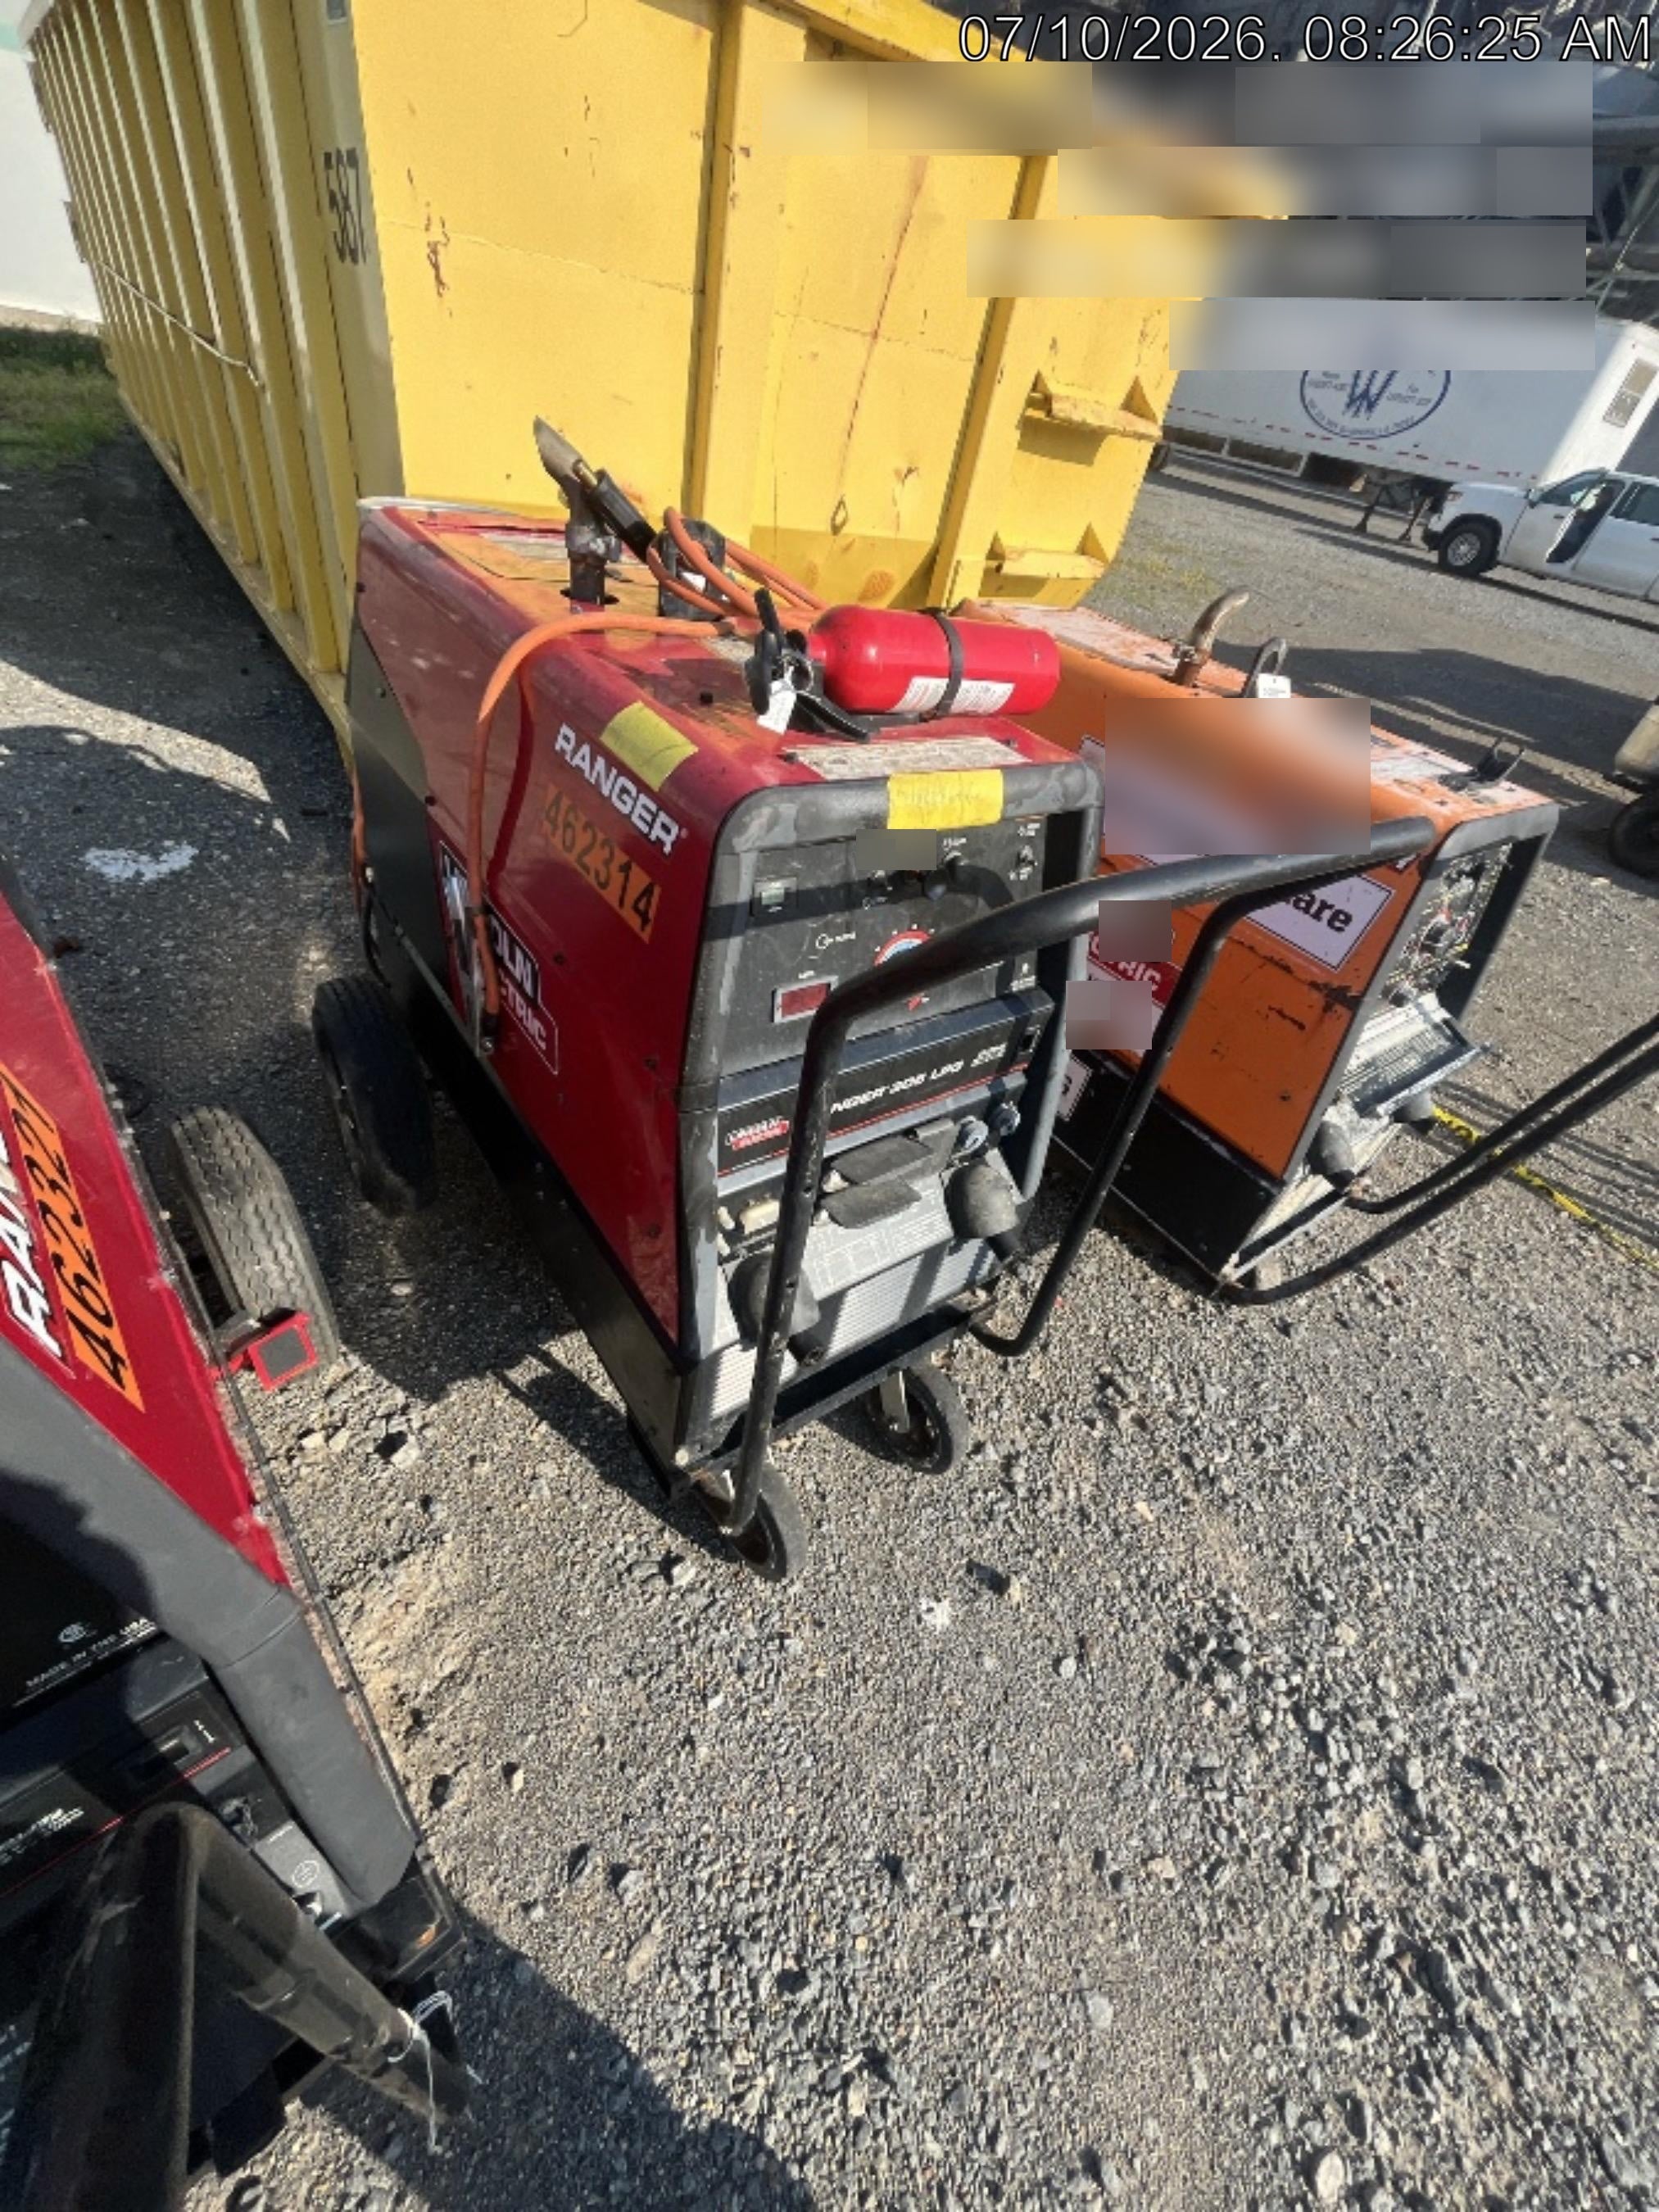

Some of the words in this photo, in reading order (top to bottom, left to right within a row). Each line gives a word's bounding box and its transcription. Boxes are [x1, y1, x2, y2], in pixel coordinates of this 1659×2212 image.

[324, 147, 367, 266] 587
[555, 722, 679, 856] RANGER
[544, 790, 656, 933] 462314
[1290, 891, 1353, 932] are
[3, 1072, 128, 1391] 462321
